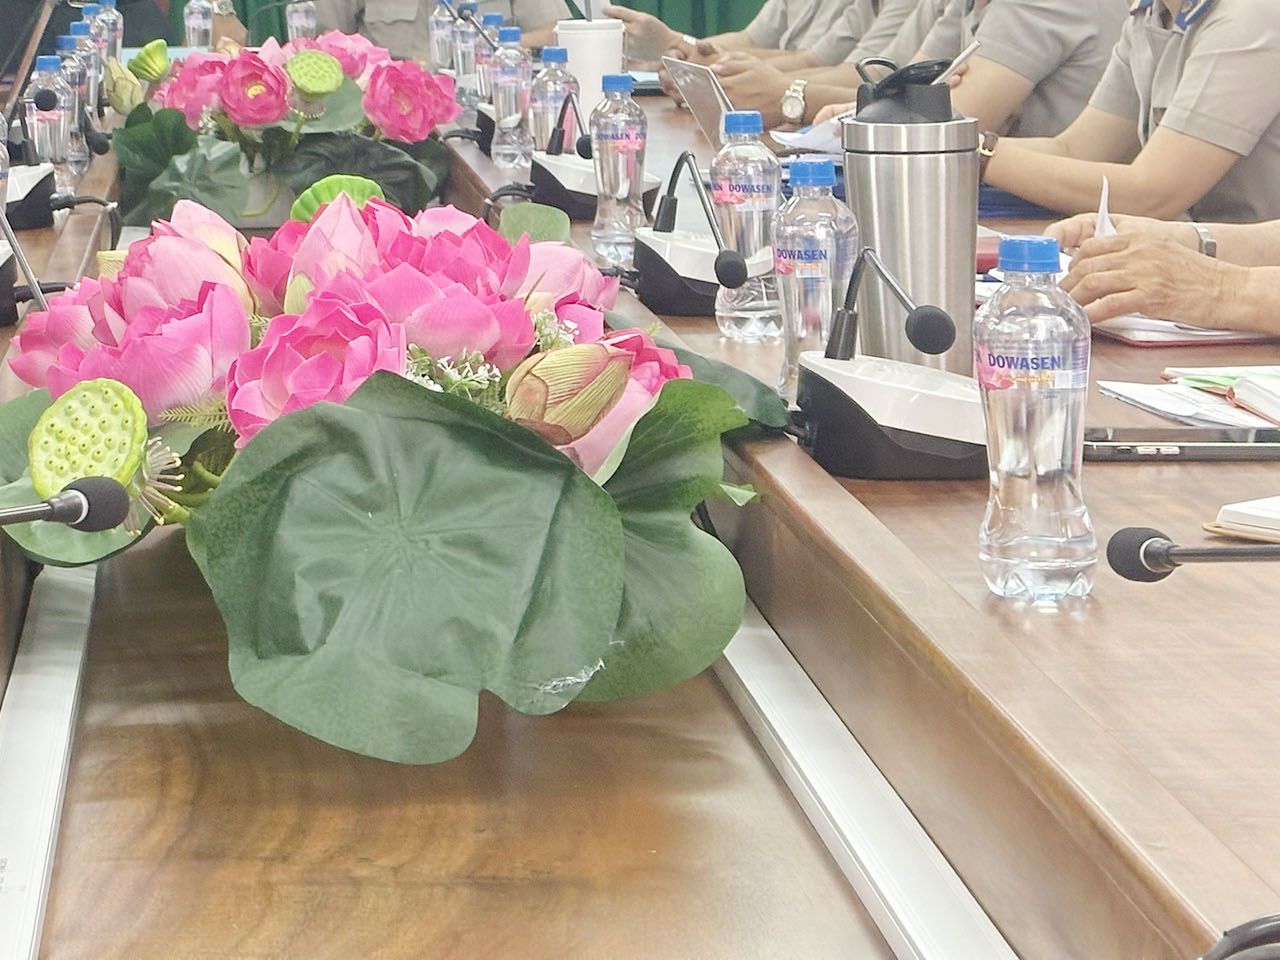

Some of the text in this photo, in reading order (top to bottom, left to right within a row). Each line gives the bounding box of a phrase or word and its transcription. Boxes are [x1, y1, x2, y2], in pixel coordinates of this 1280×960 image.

[728, 183, 772, 193] DOWASEN
[776, 248, 827, 260] DOWASEN
[987, 353, 1062, 370] DOWASEN
